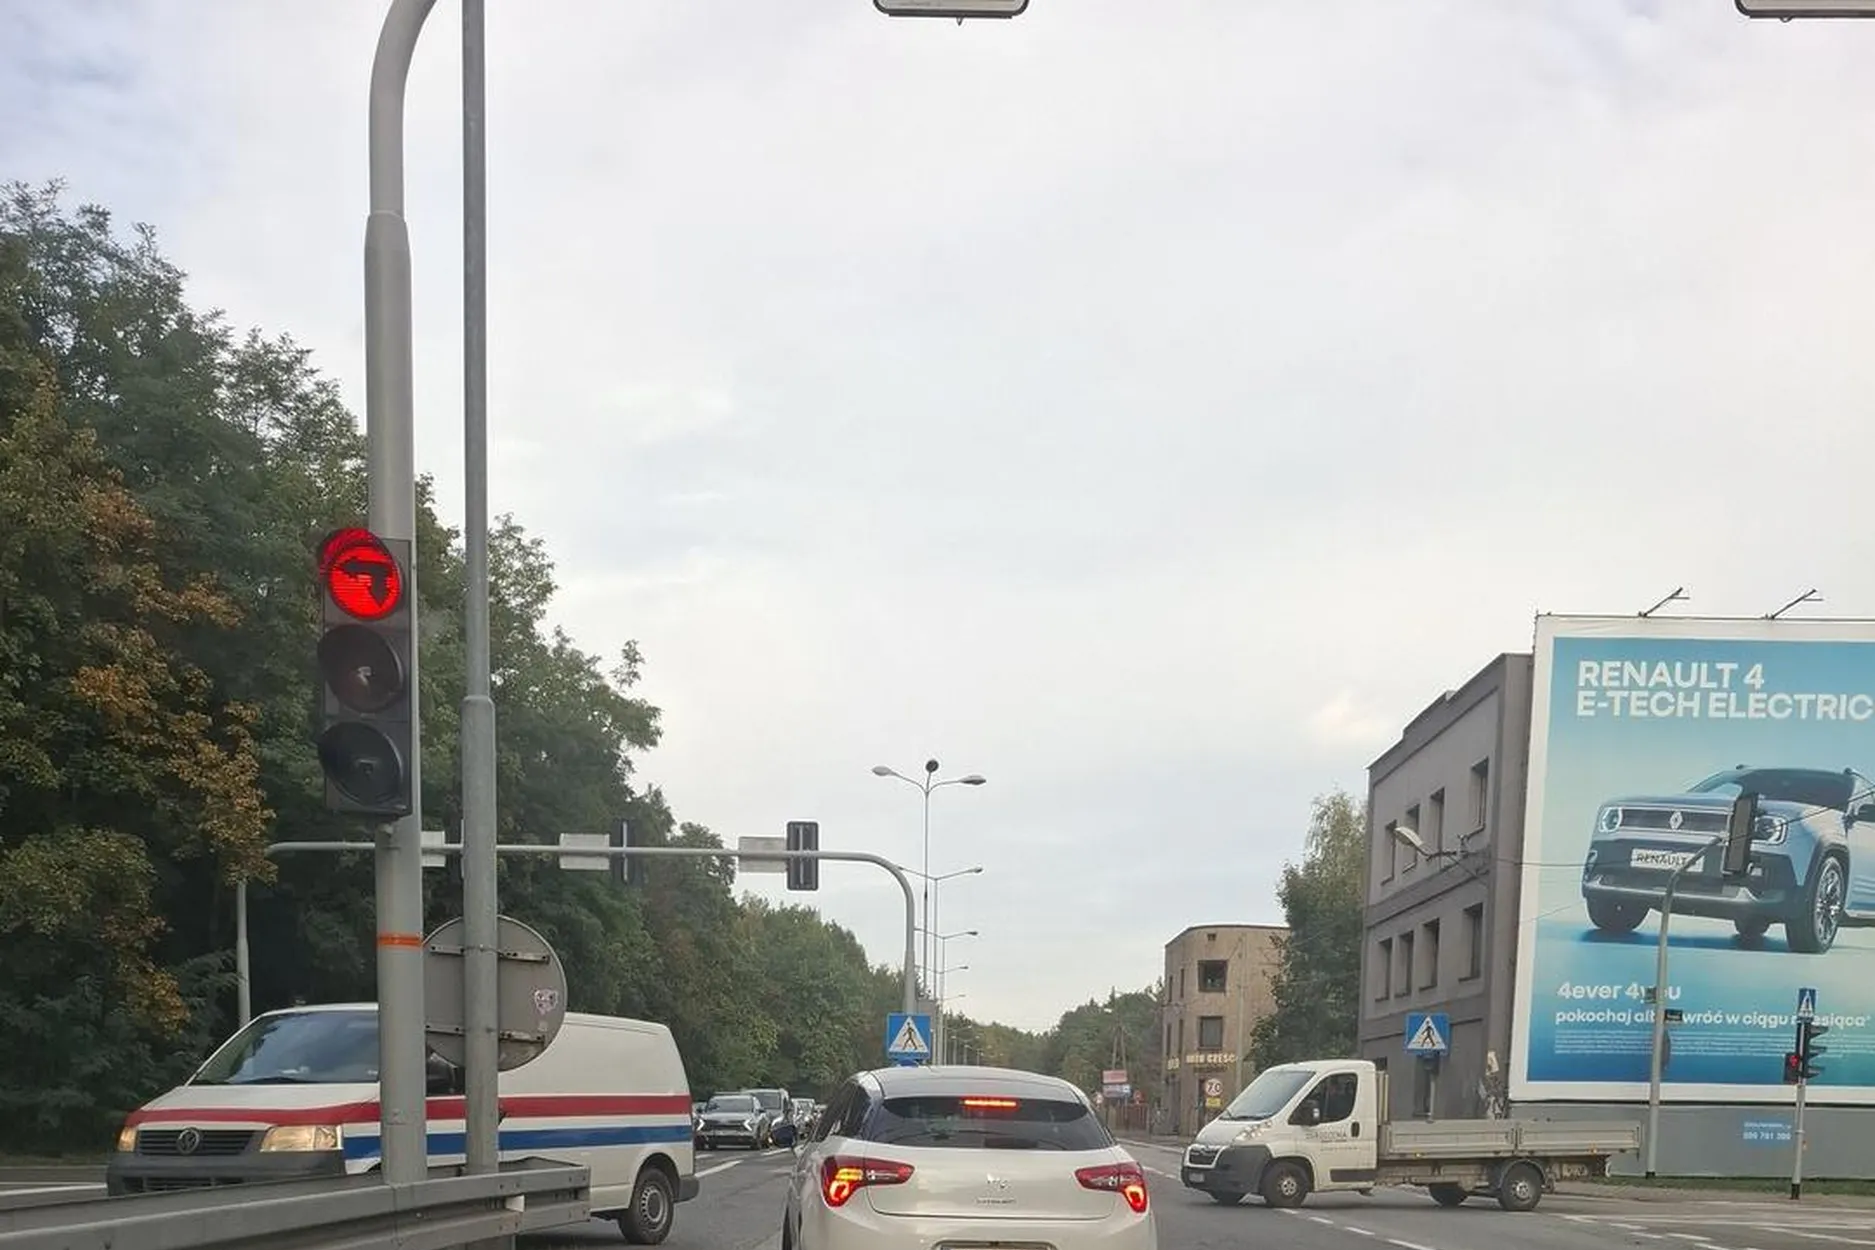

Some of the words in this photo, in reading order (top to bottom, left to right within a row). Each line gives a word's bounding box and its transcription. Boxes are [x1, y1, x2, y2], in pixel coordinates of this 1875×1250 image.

[1578, 661, 1738, 689] RENAULT
[1744, 663, 1765, 690] 4
[1577, 690, 1699, 718] E-TECH
[1708, 692, 1875, 721] ELECTRIC
[1556, 981, 1622, 999] 4ever
[1555, 1008, 1631, 1025] pokochaj
[1676, 1009, 1723, 1024] wróć
[1725, 1013, 1739, 1025] w
[1742, 1011, 1787, 1028] ciągu
[1207, 1082, 1222, 1093] 70
